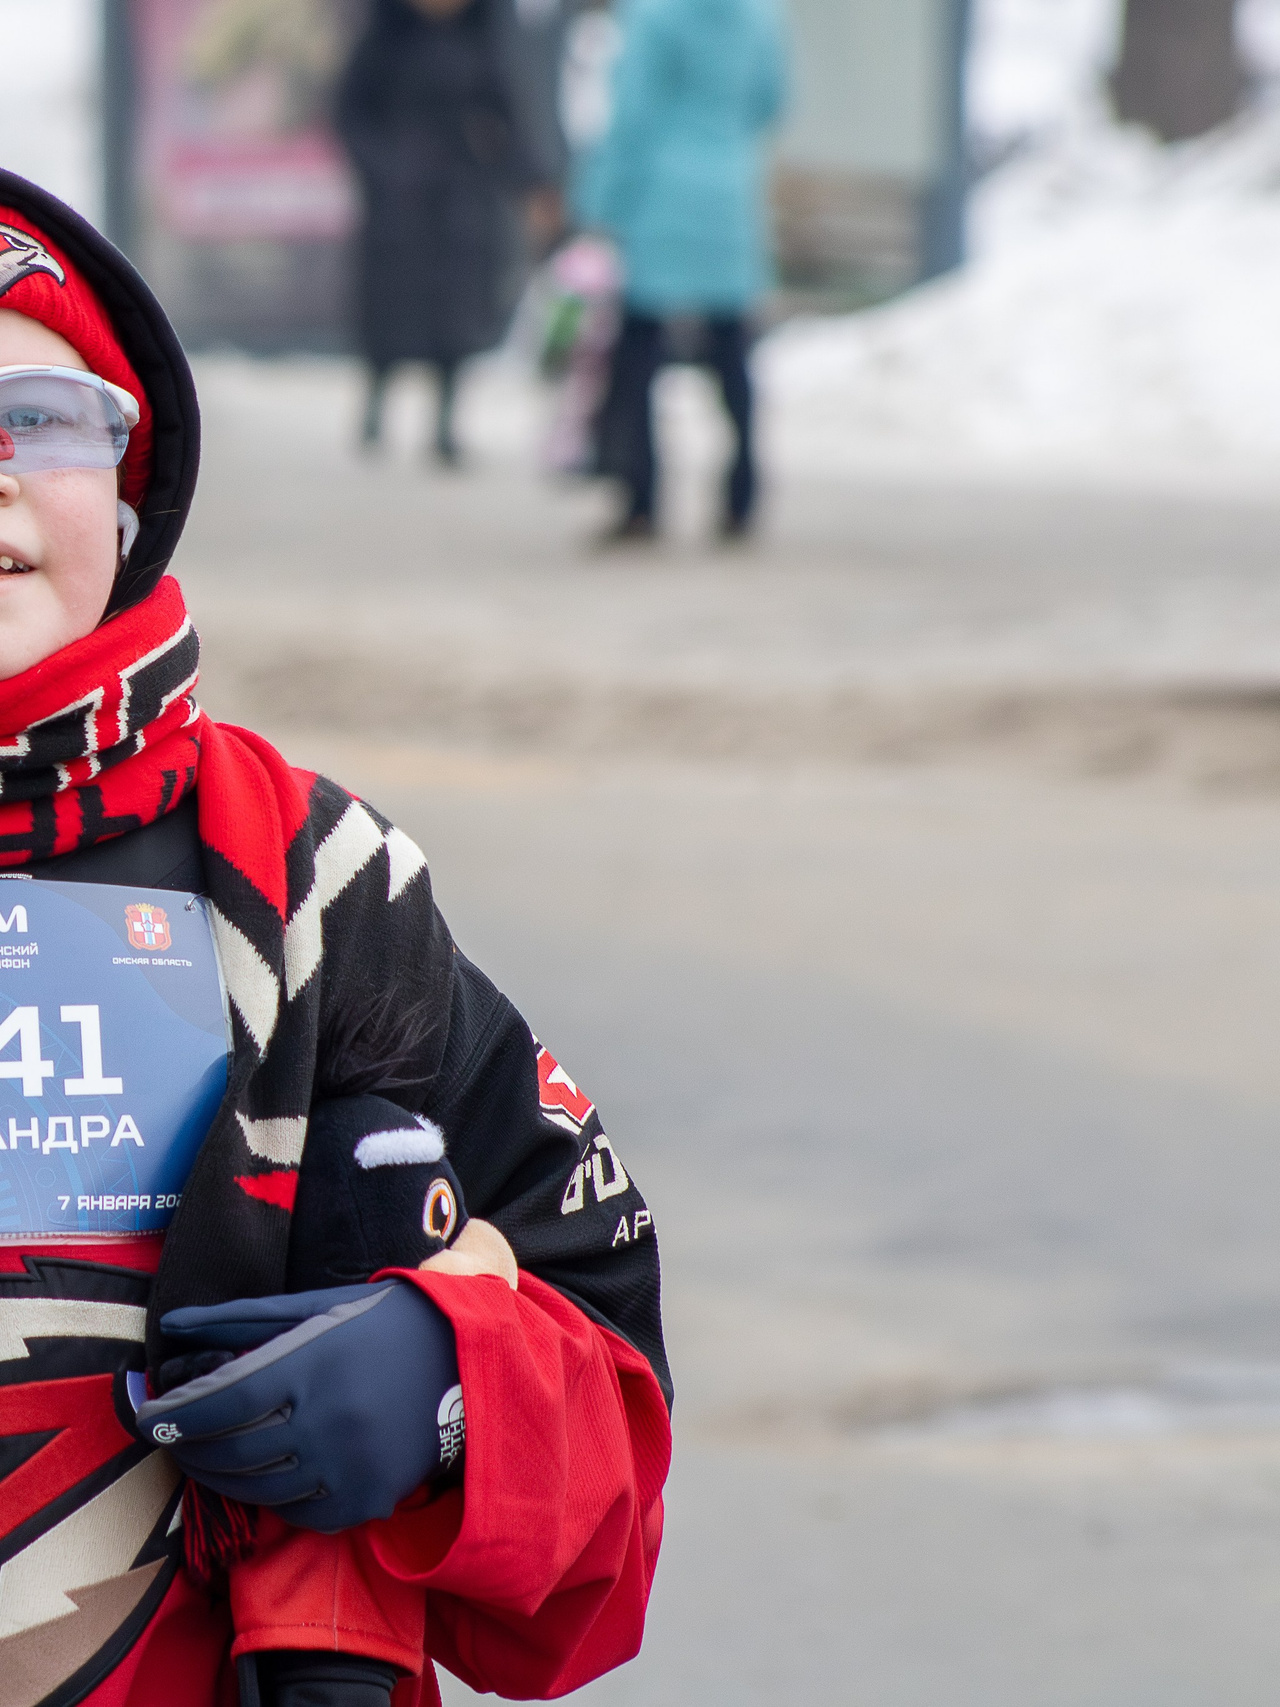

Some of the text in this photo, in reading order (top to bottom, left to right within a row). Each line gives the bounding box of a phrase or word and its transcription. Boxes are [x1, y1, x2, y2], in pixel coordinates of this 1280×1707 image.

[112, 957, 193, 967] ОМСКАЯ ОБЛАСТЬ
[57, 1193, 183, 1211] 7 ЯНВАРЯ 20
